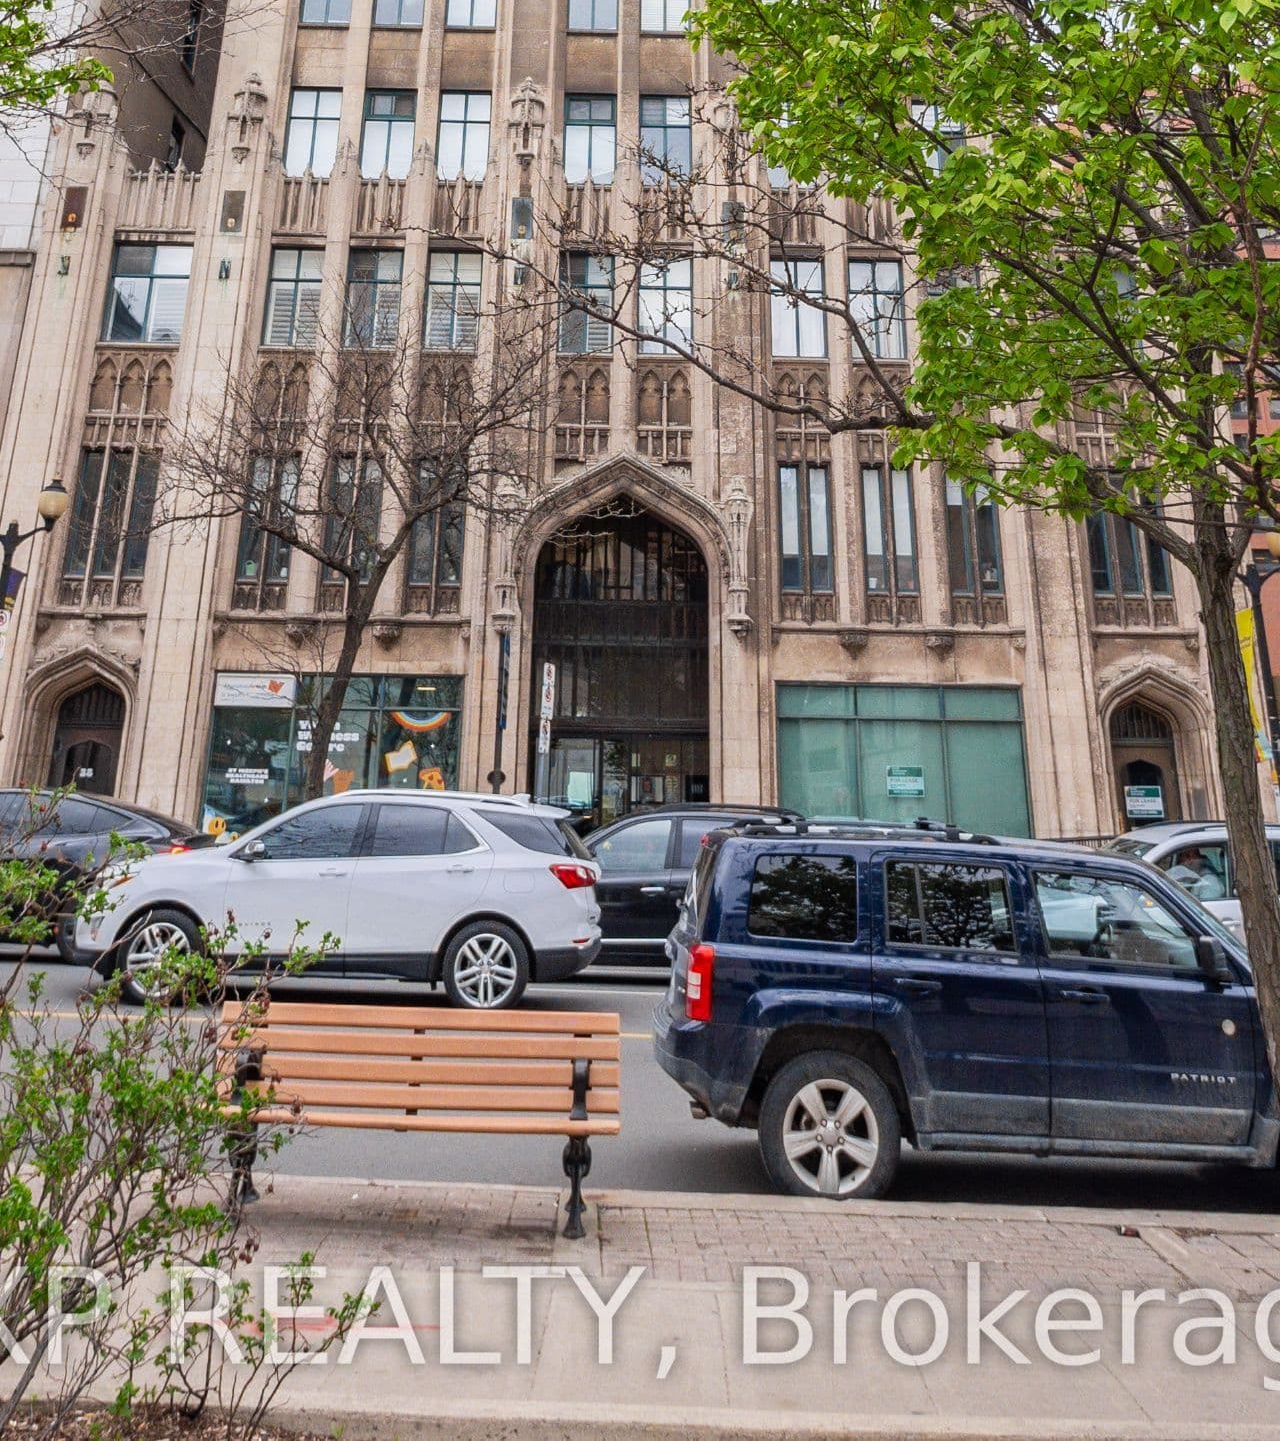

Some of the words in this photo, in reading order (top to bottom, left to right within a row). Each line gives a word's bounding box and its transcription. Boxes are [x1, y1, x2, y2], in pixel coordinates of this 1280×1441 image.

[298, 719, 341, 730] Yoh
[297, 730, 360, 741] Wness
[296, 741, 345, 752] Cere
[1170, 1072, 1237, 1084] PATRIOT
